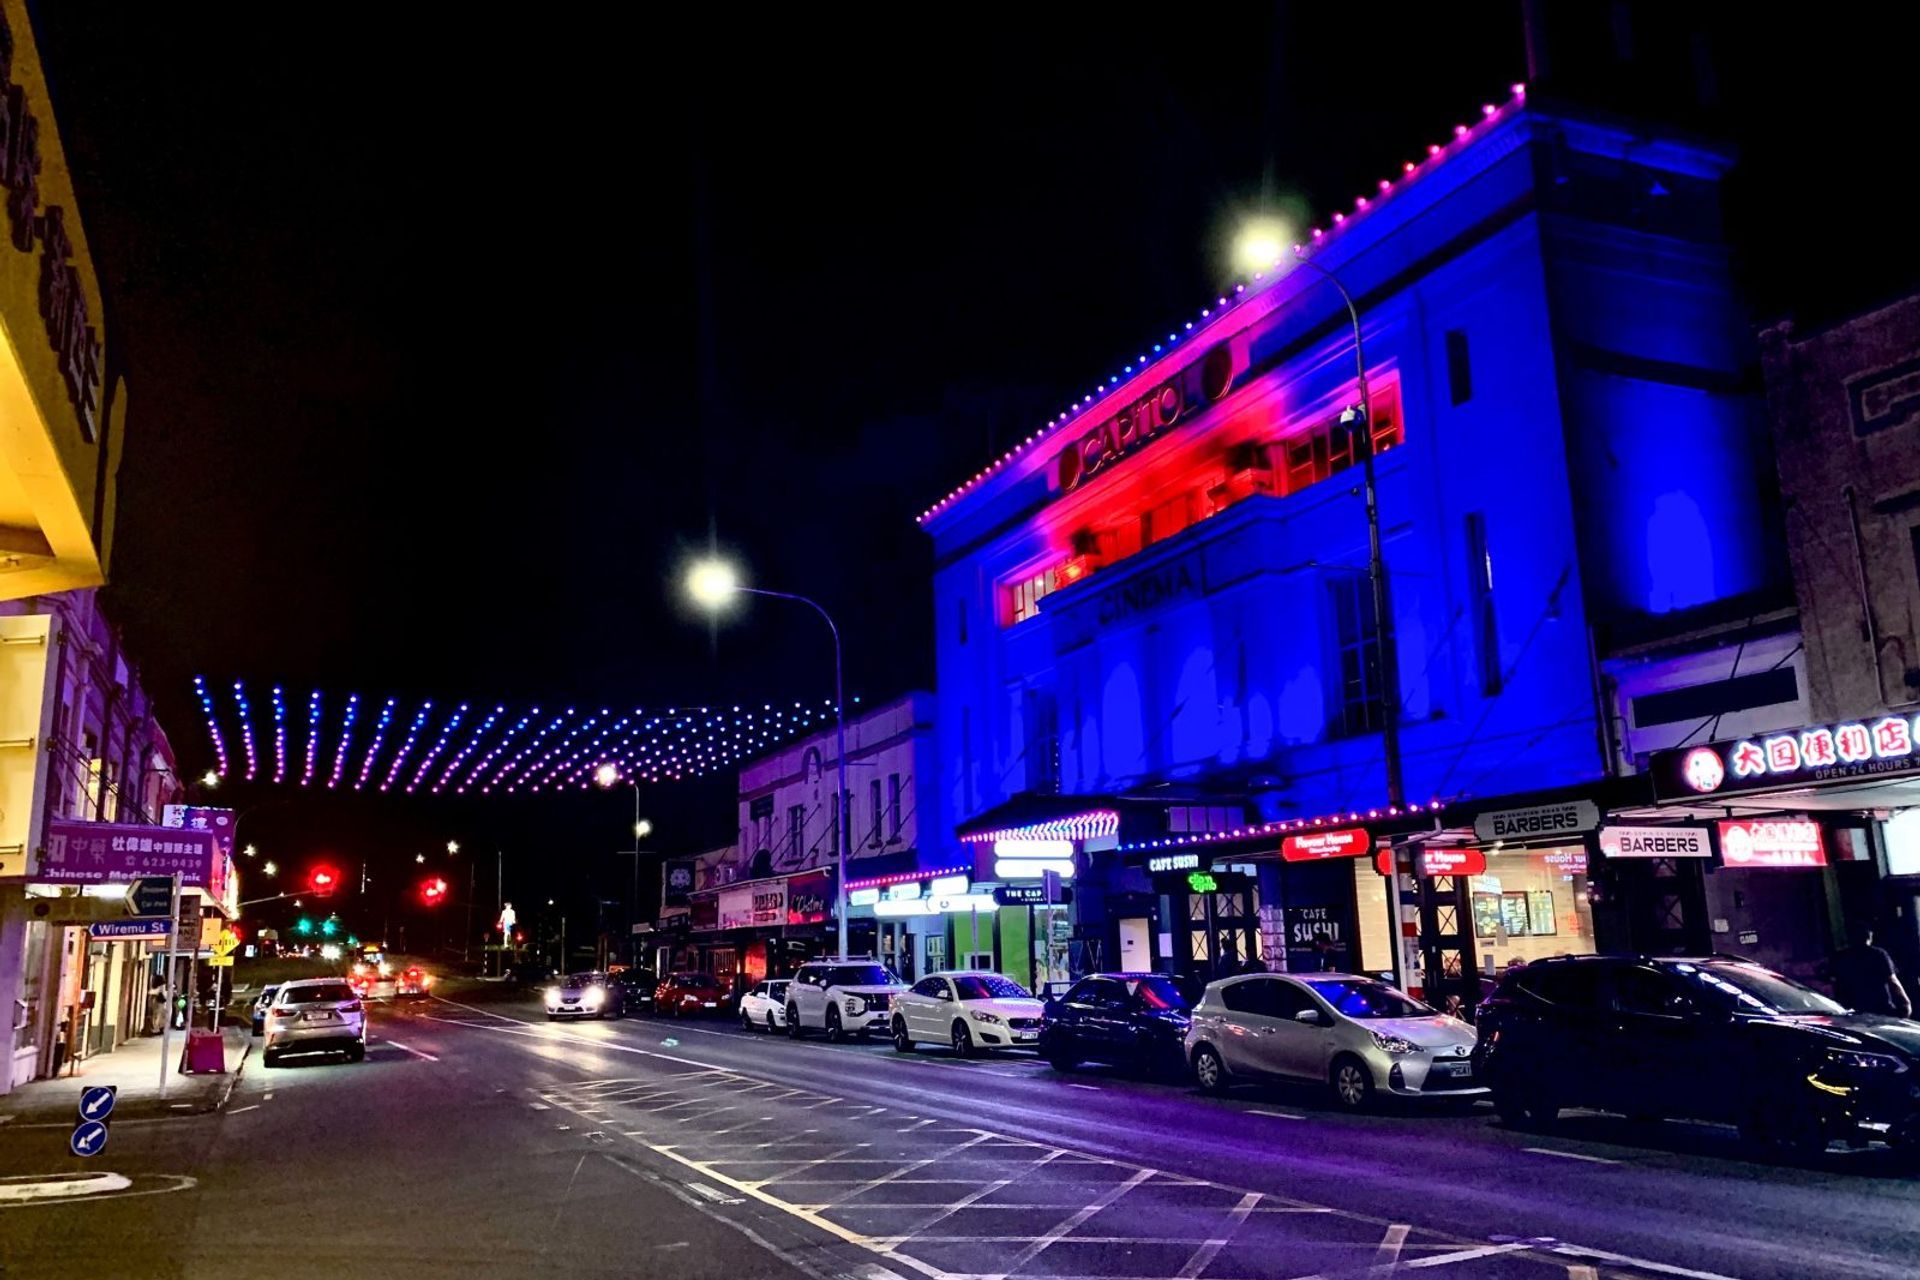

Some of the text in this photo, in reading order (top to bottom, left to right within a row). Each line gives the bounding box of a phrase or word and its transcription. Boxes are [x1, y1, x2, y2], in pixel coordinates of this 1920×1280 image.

[1083, 377, 1200, 475] CAPITOL
[1098, 563, 1193, 625] CINEMA
[1735, 719, 1909, 774] 大国便利店
[1815, 766, 1847, 780] OPEN
[1851, 765, 1865, 776] 24
[1868, 759, 1911, 772] HOURS
[1493, 812, 1579, 836] BARBERS
[1620, 837, 1699, 852] BARBERS
[1150, 854, 1199, 872] CAFE SUSHI
[1434, 850, 1467, 862] House
[1005, 890, 1022, 898] THE
[1303, 908, 1326, 919] CAFE
[98, 922, 165, 935] Wiremu St
[1293, 922, 1339, 942] SUSHI
